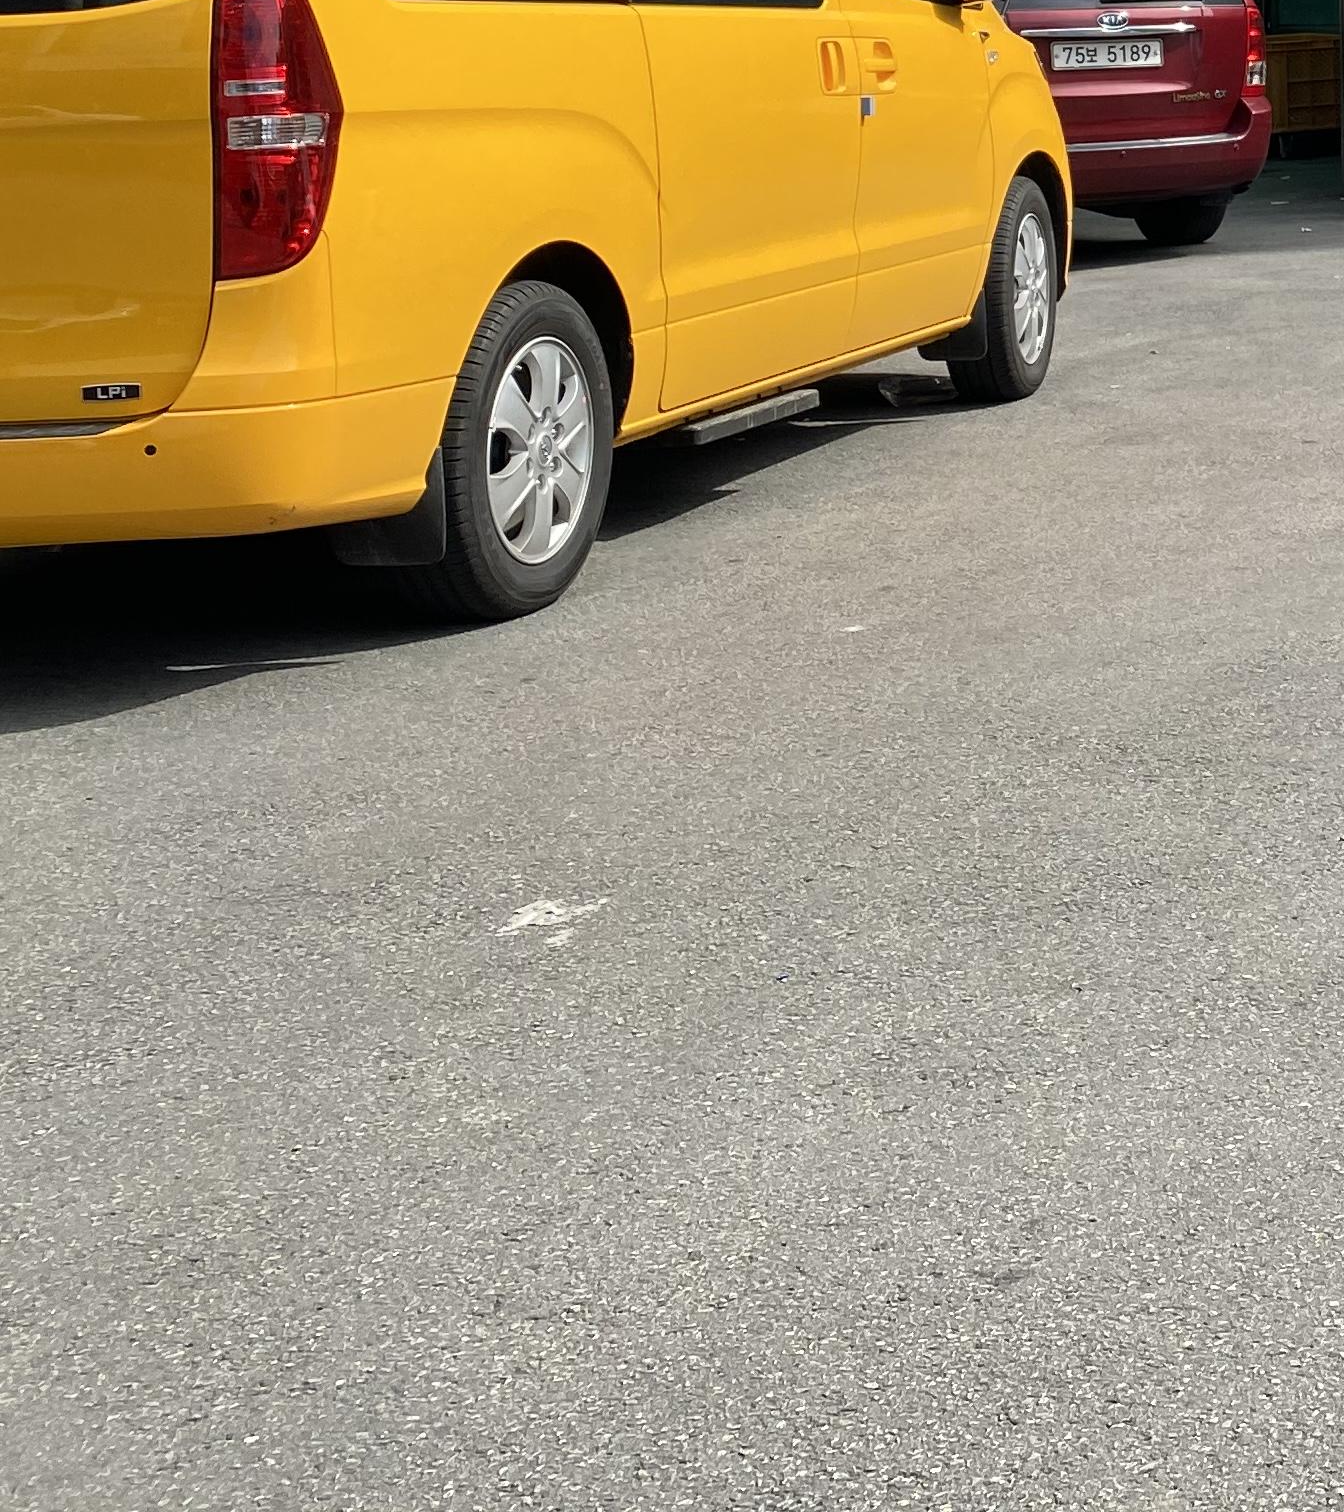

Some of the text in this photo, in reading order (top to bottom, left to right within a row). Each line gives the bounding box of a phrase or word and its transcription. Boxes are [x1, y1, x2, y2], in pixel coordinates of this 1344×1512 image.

[1062, 44, 1151, 65] 75보 5189
[96, 386, 127, 399] LPi
